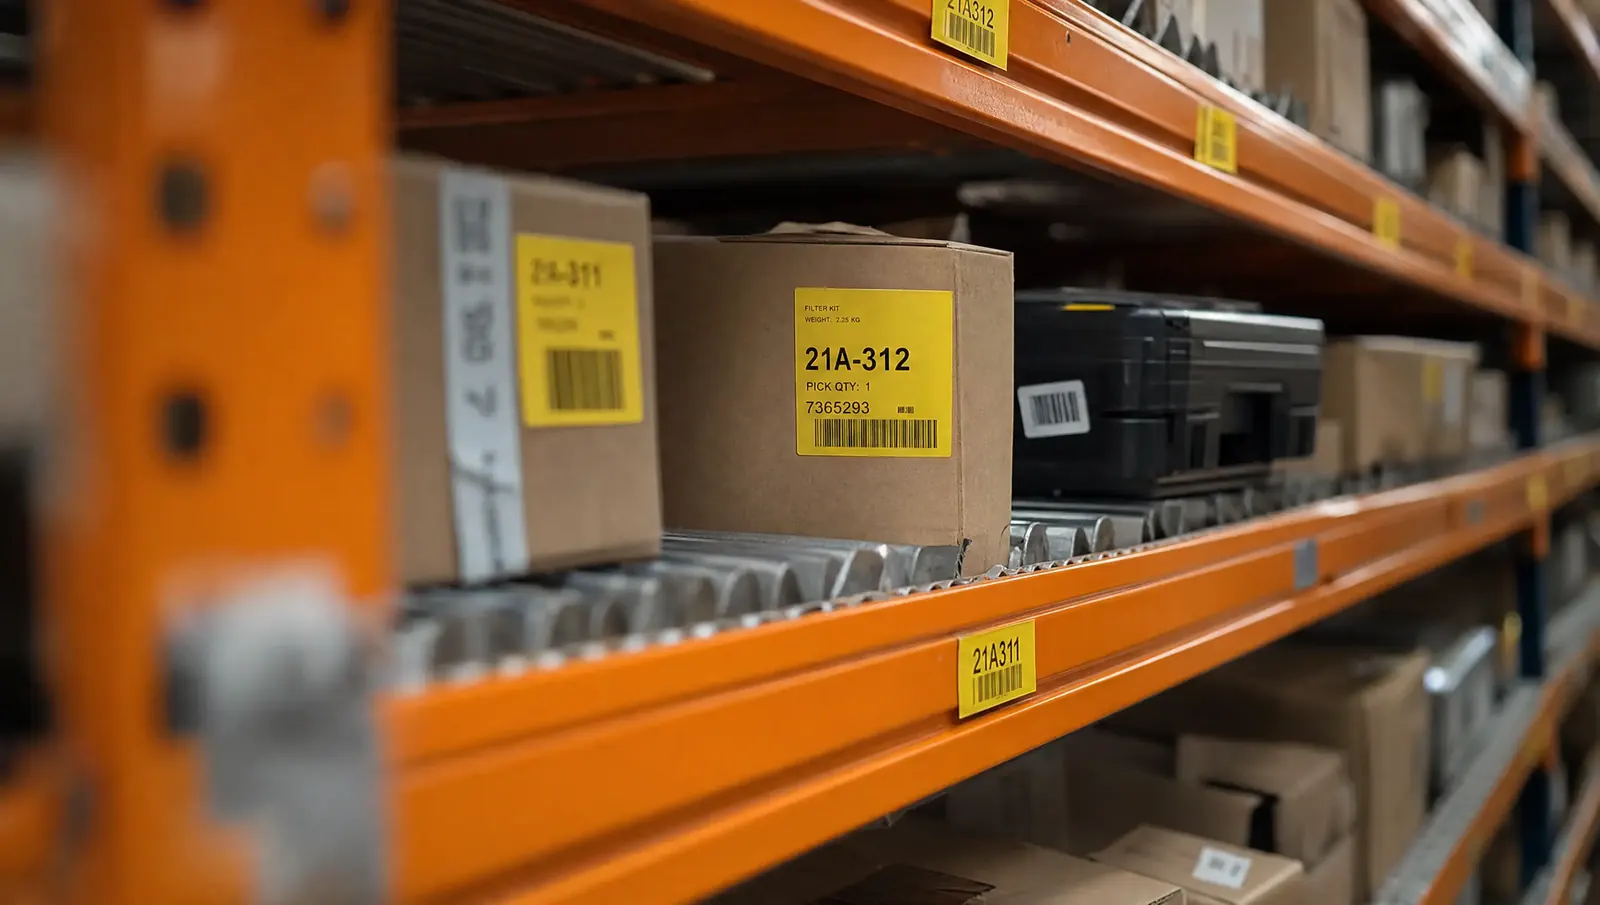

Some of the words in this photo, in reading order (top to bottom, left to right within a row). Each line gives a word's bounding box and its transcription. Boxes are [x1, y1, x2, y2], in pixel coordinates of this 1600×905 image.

[805, 346, 910, 371] 21A-312
[806, 381, 832, 391] PICK
[834, 381, 860, 392] QTY:
[865, 382, 871, 391] 1
[805, 401, 870, 414] 7365293
[973, 636, 1020, 675] 21A311
